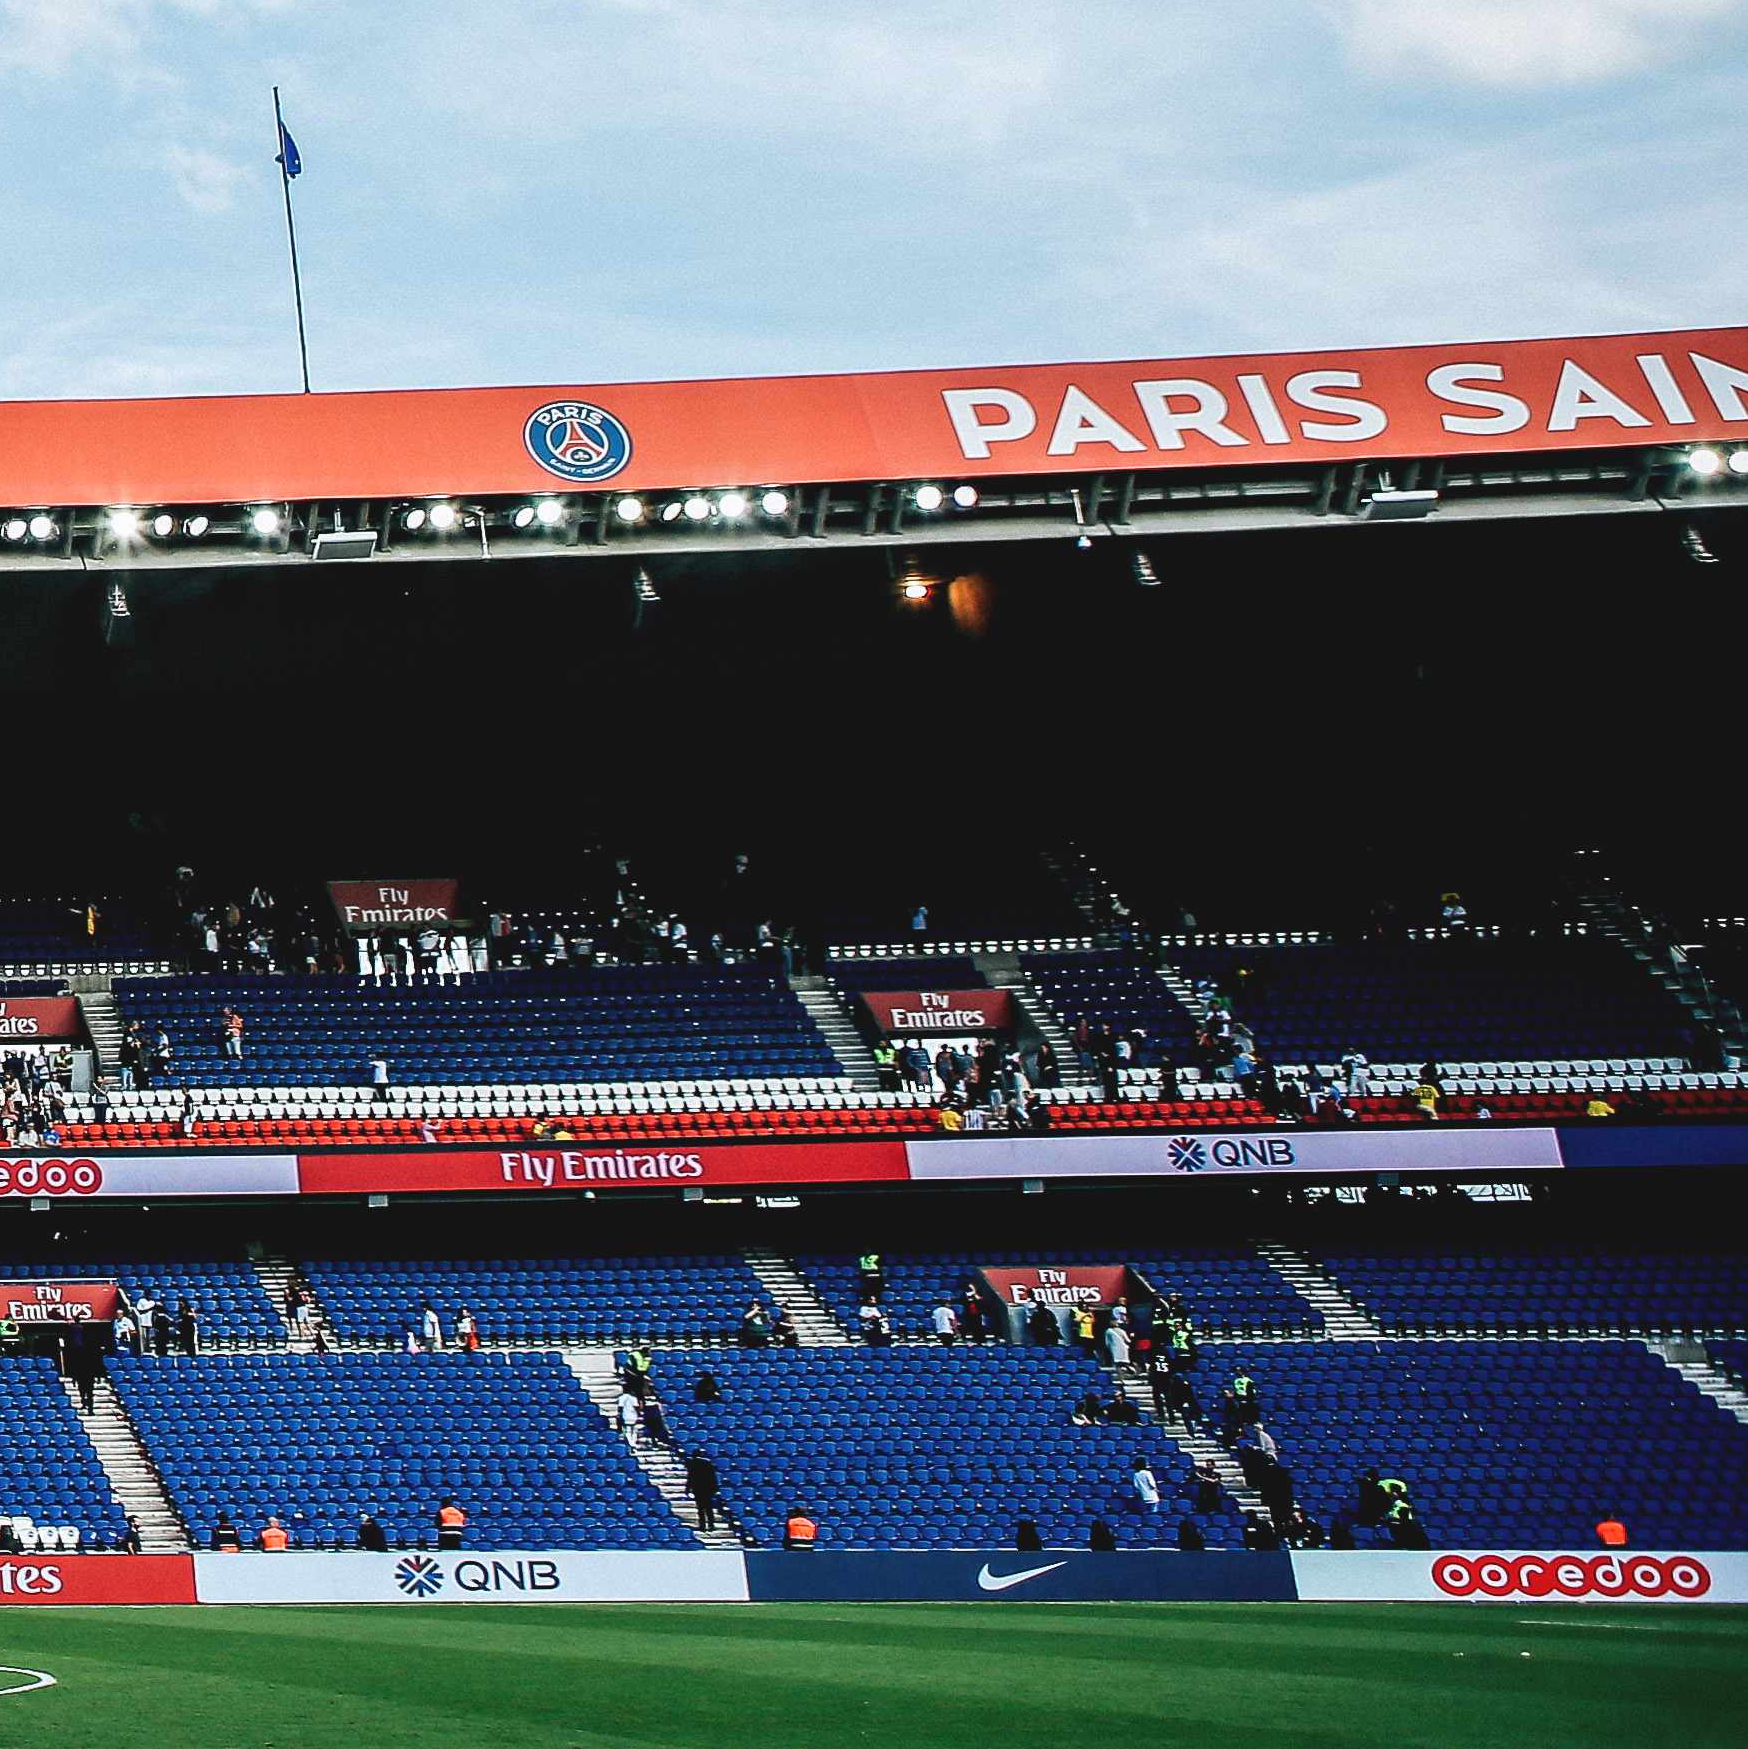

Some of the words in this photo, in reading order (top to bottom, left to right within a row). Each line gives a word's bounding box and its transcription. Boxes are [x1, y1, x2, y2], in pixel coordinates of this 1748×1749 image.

[536, 406, 604, 426] PARIS
[927, 369, 1389, 459] PARIS
[379, 887, 409, 905] Fly
[345, 905, 447, 923] Emirates
[921, 992, 950, 1009] Fly
[891, 1007, 985, 1030] Emirates
[1213, 1139, 1296, 1166] QNB
[500, 1152, 554, 1186] Fly
[560, 1151, 703, 1182] Emirates
[1038, 1269, 1066, 1286] Fly
[36, 1286, 62, 1302] Fly
[454, 1560, 561, 1592] QNB
[1439, 1556, 1703, 1591] ooredoo
